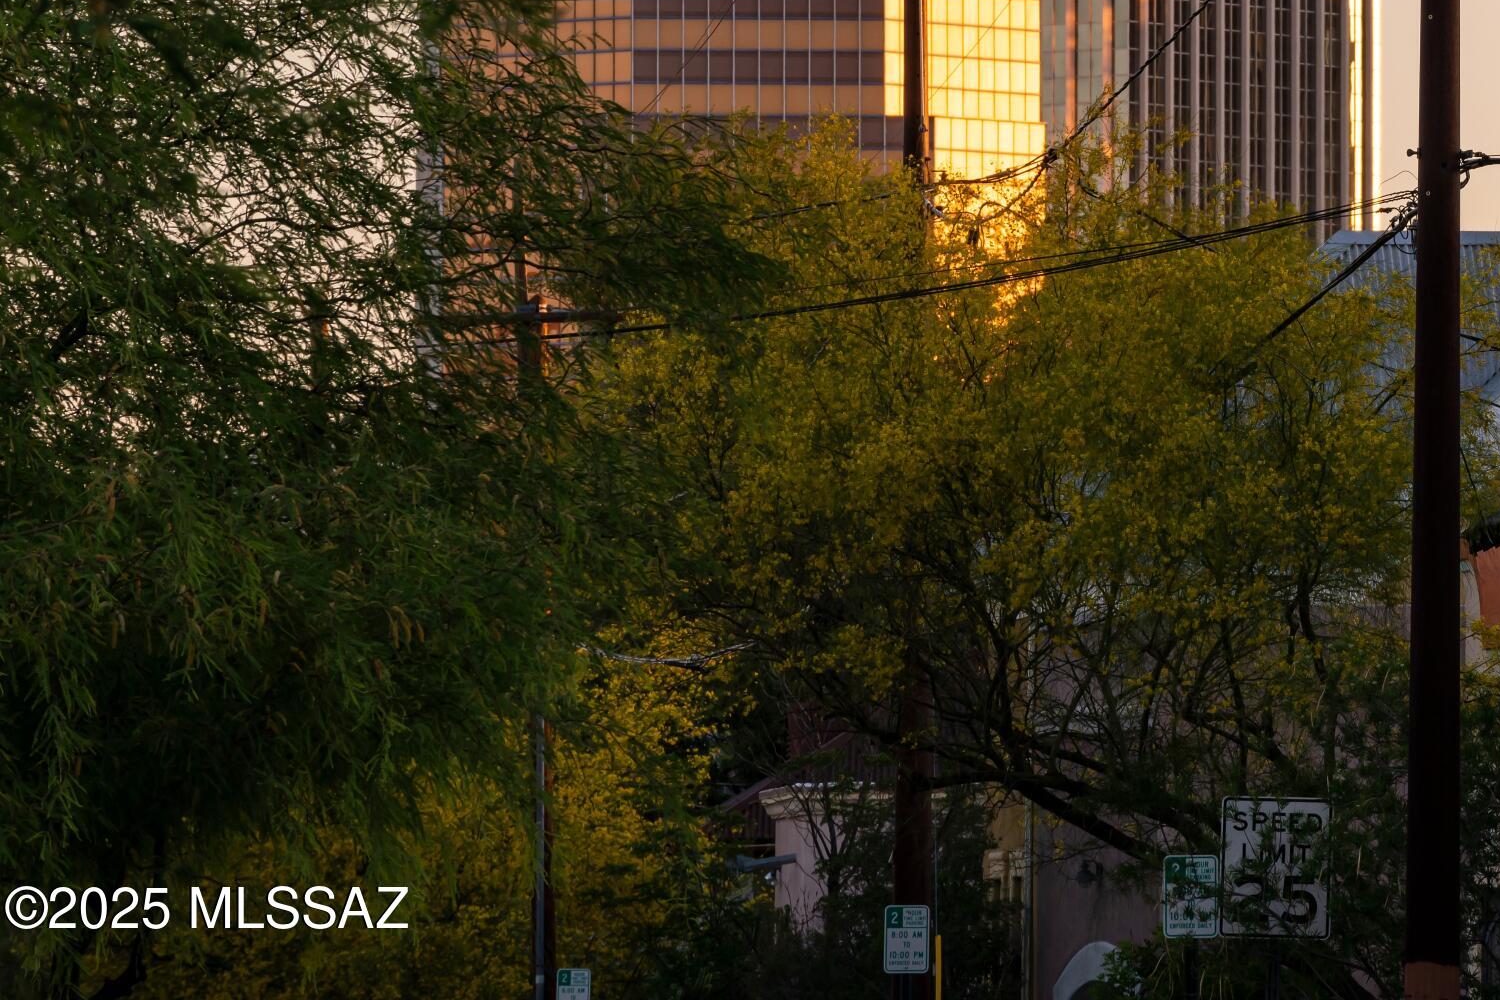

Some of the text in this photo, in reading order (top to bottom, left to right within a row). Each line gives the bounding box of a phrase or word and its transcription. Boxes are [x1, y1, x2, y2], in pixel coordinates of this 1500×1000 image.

[1233, 811, 1322, 832] SPEED
[1242, 843, 1311, 864] LIMIT
[1233, 874, 1318, 925] 25
[891, 911, 898, 924] 2
[889, 951, 924, 959] 10:00 PM
[560, 973, 567, 983] 2
